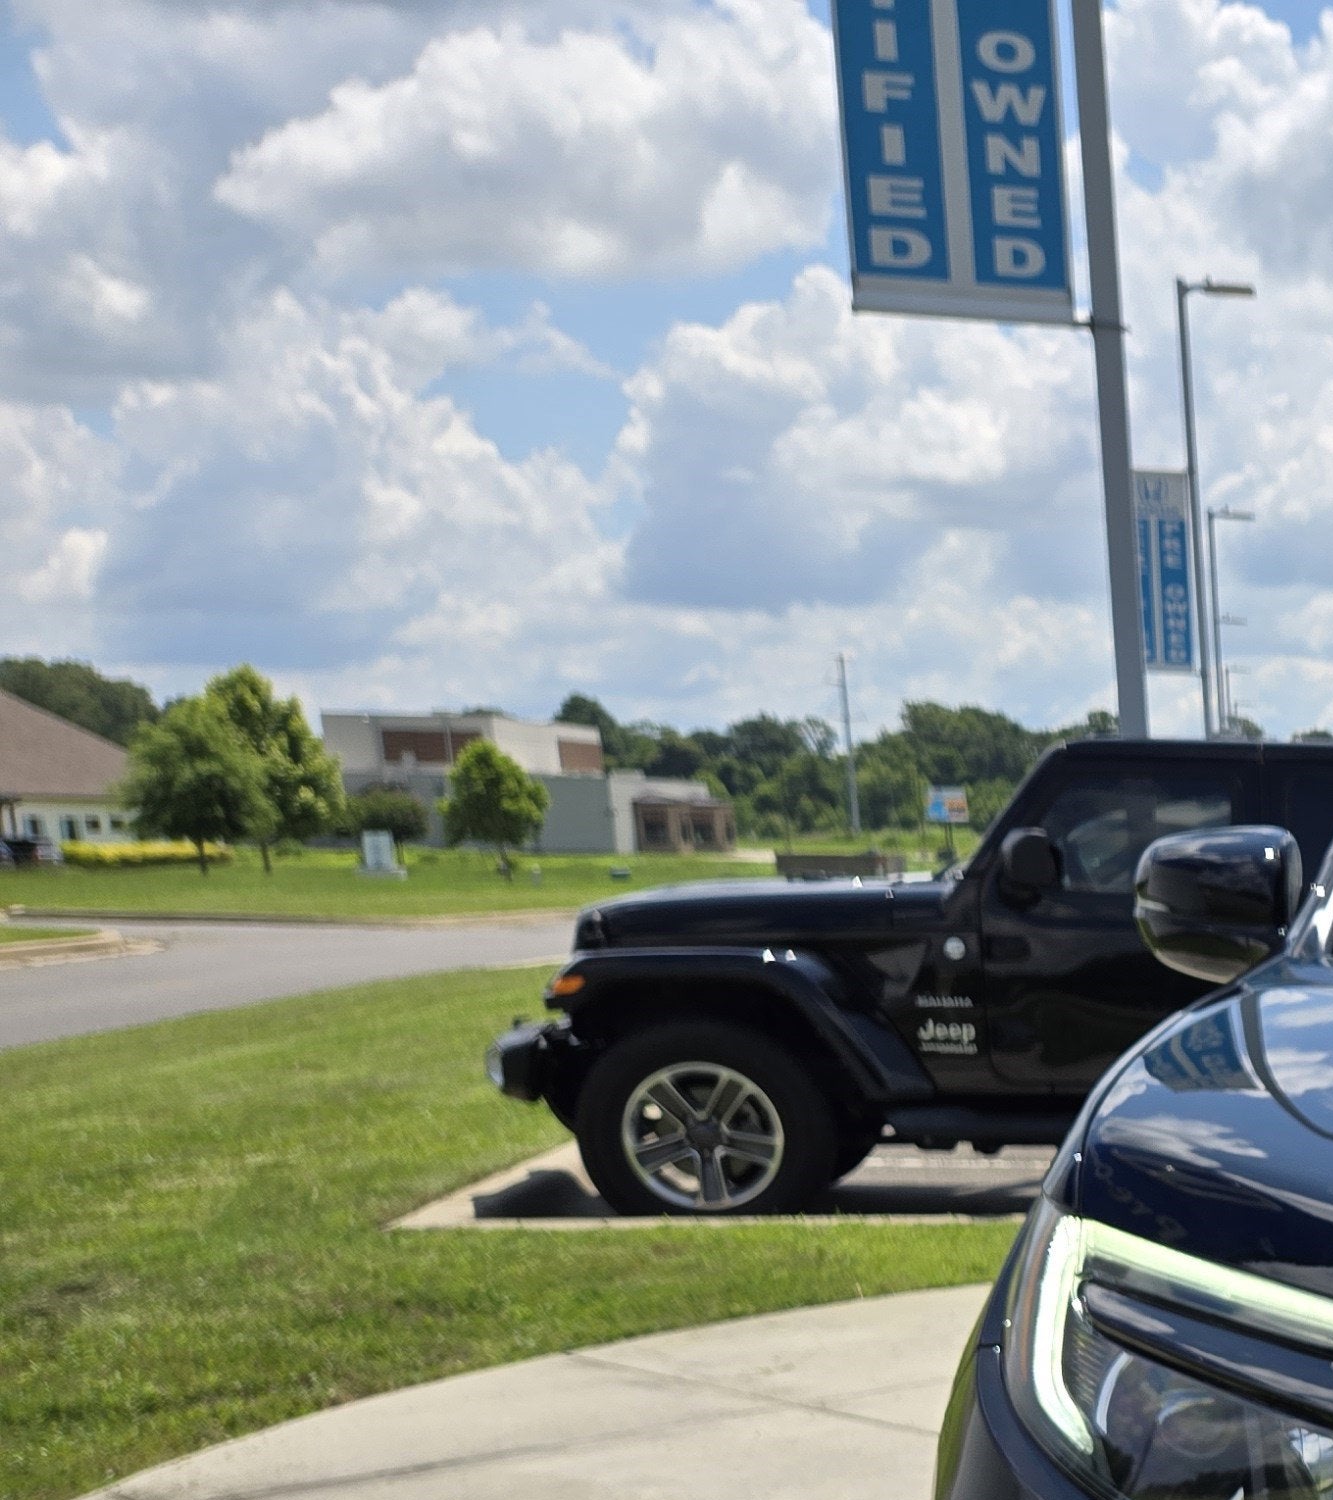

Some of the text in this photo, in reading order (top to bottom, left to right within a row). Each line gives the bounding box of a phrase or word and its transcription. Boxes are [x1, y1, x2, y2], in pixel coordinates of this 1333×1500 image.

[861, 0, 932, 268] IFIED
[971, 31, 1046, 279] OWNED
[917, 1018, 976, 1045] Jeep
